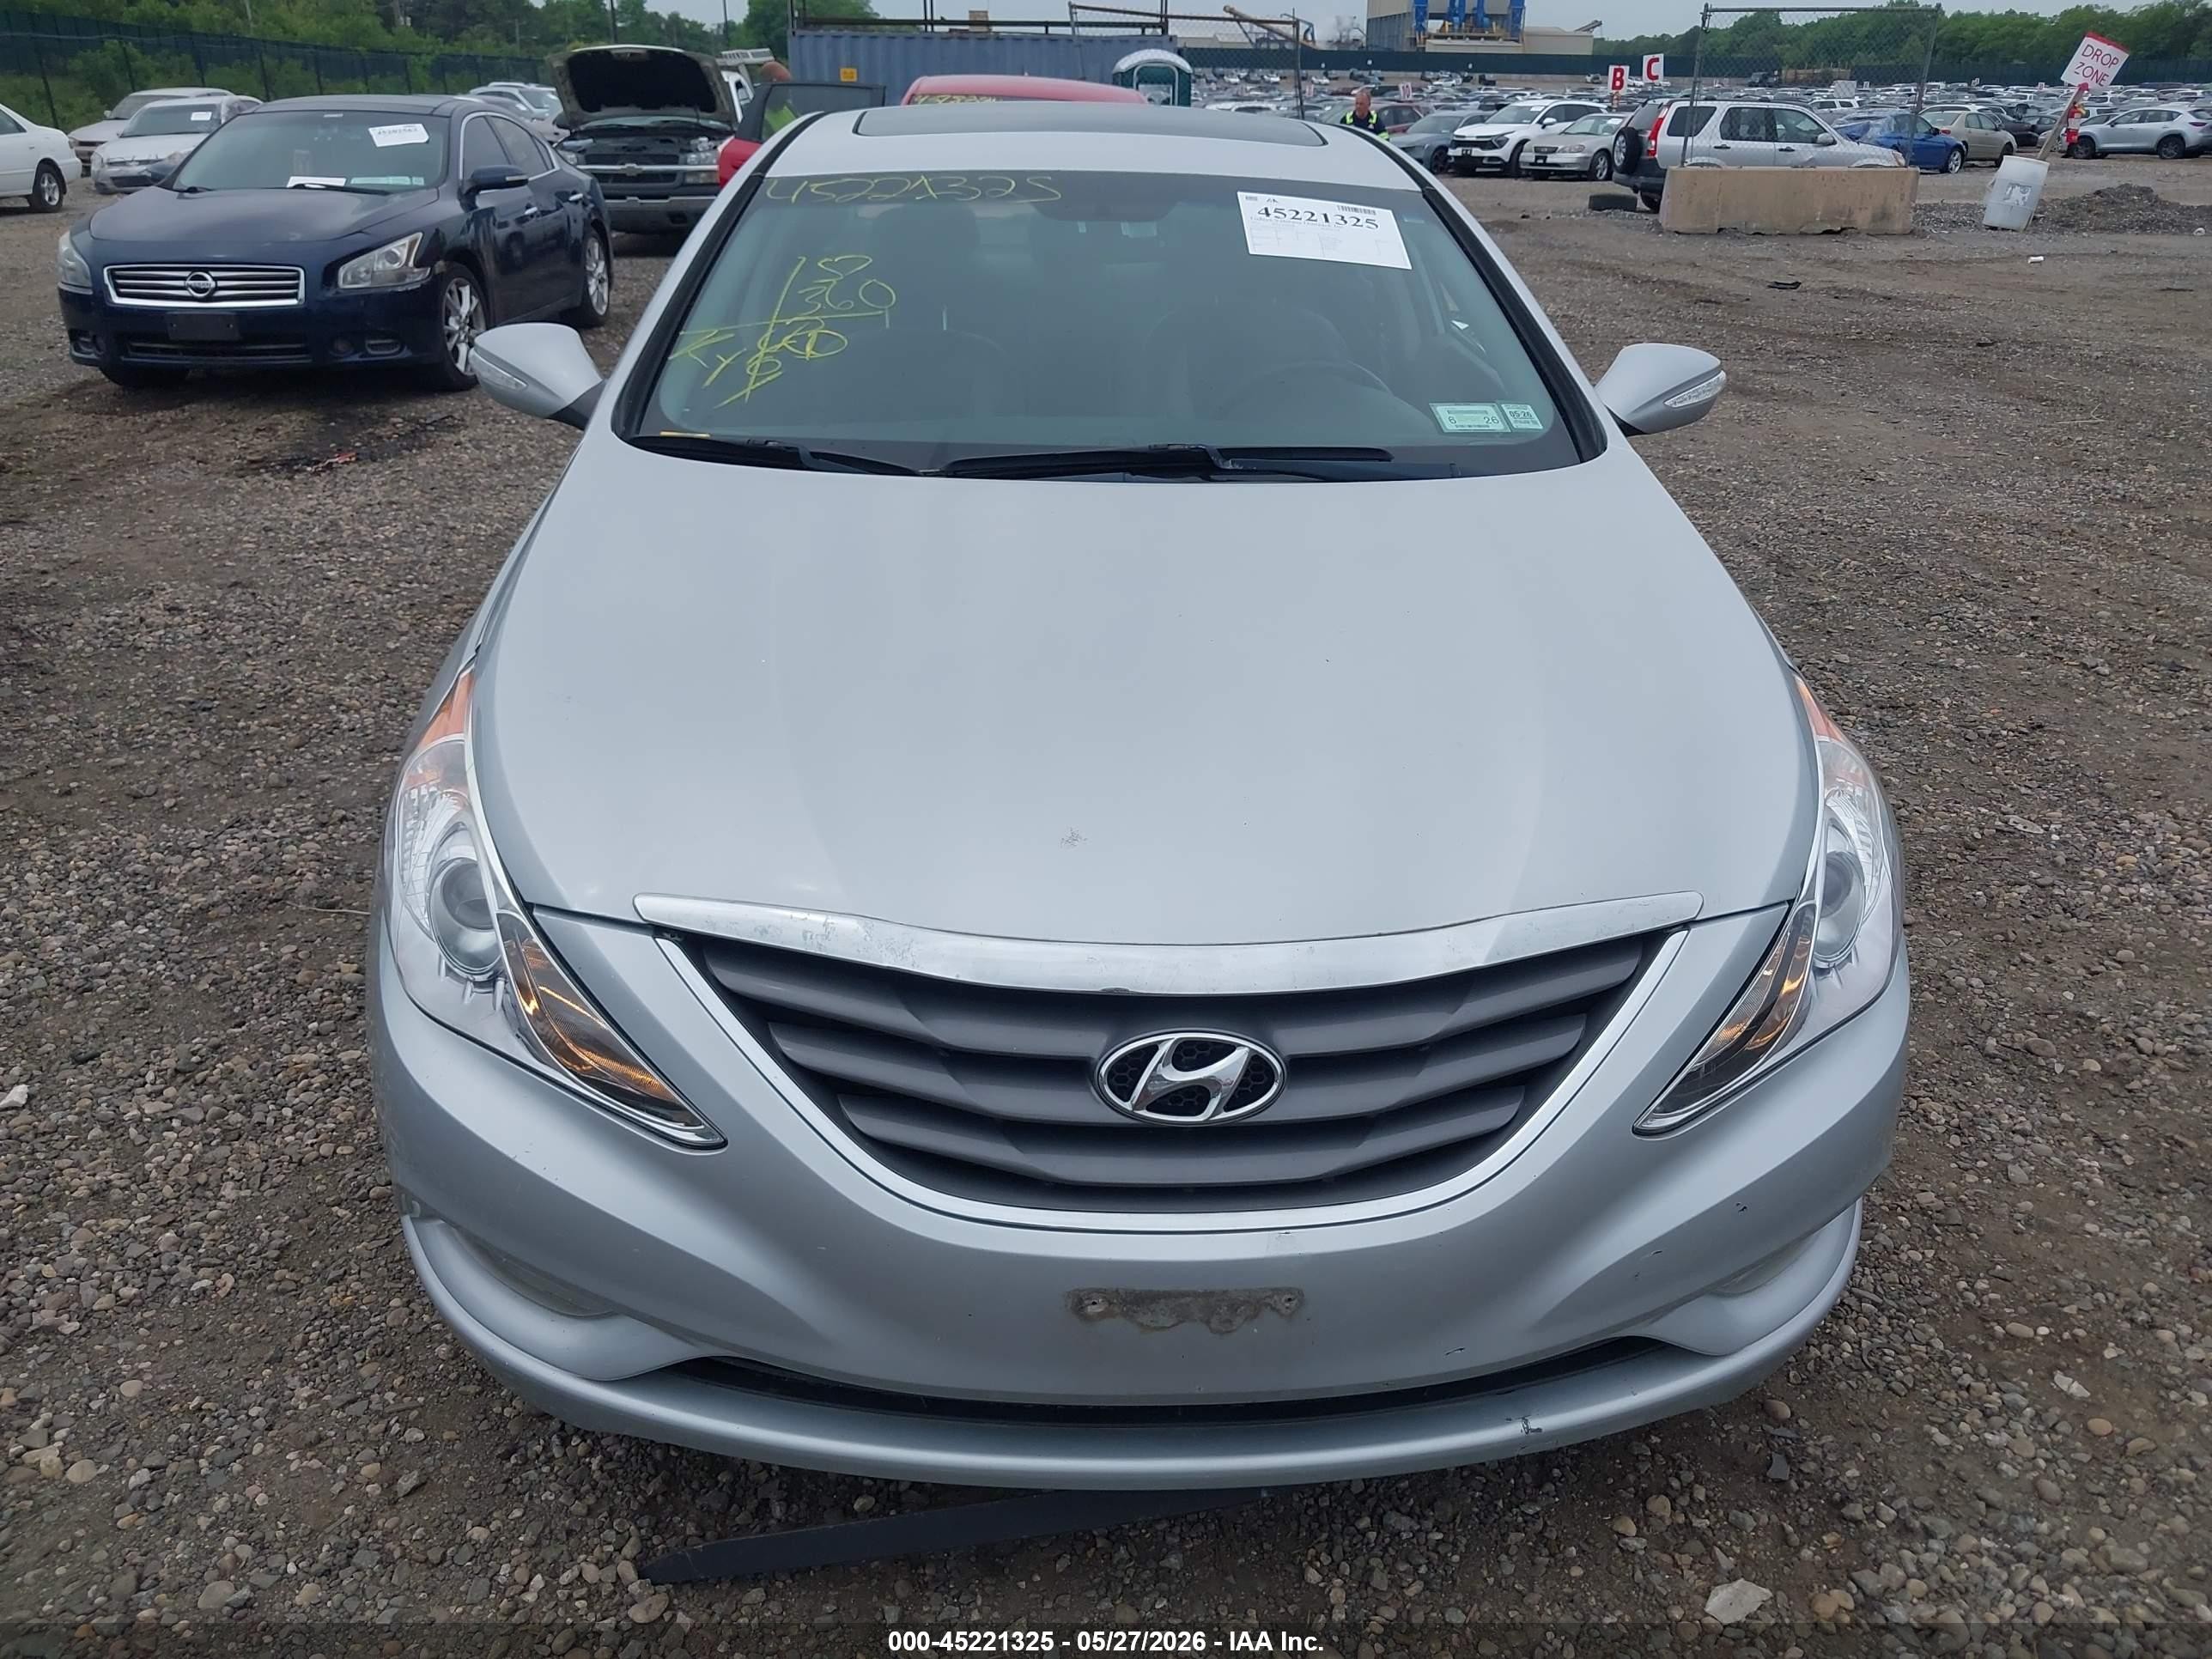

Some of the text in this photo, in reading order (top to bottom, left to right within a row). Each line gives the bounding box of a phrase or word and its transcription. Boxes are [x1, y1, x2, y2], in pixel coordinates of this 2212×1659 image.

[2081, 44, 2119, 69] DROP
[1612, 67, 1625, 91] B
[1647, 57, 1660, 81] C
[2074, 61, 2110, 87] ZONE
[1257, 206, 1379, 230] 45221325
[1448, 416, 1499, 424] 6 26
